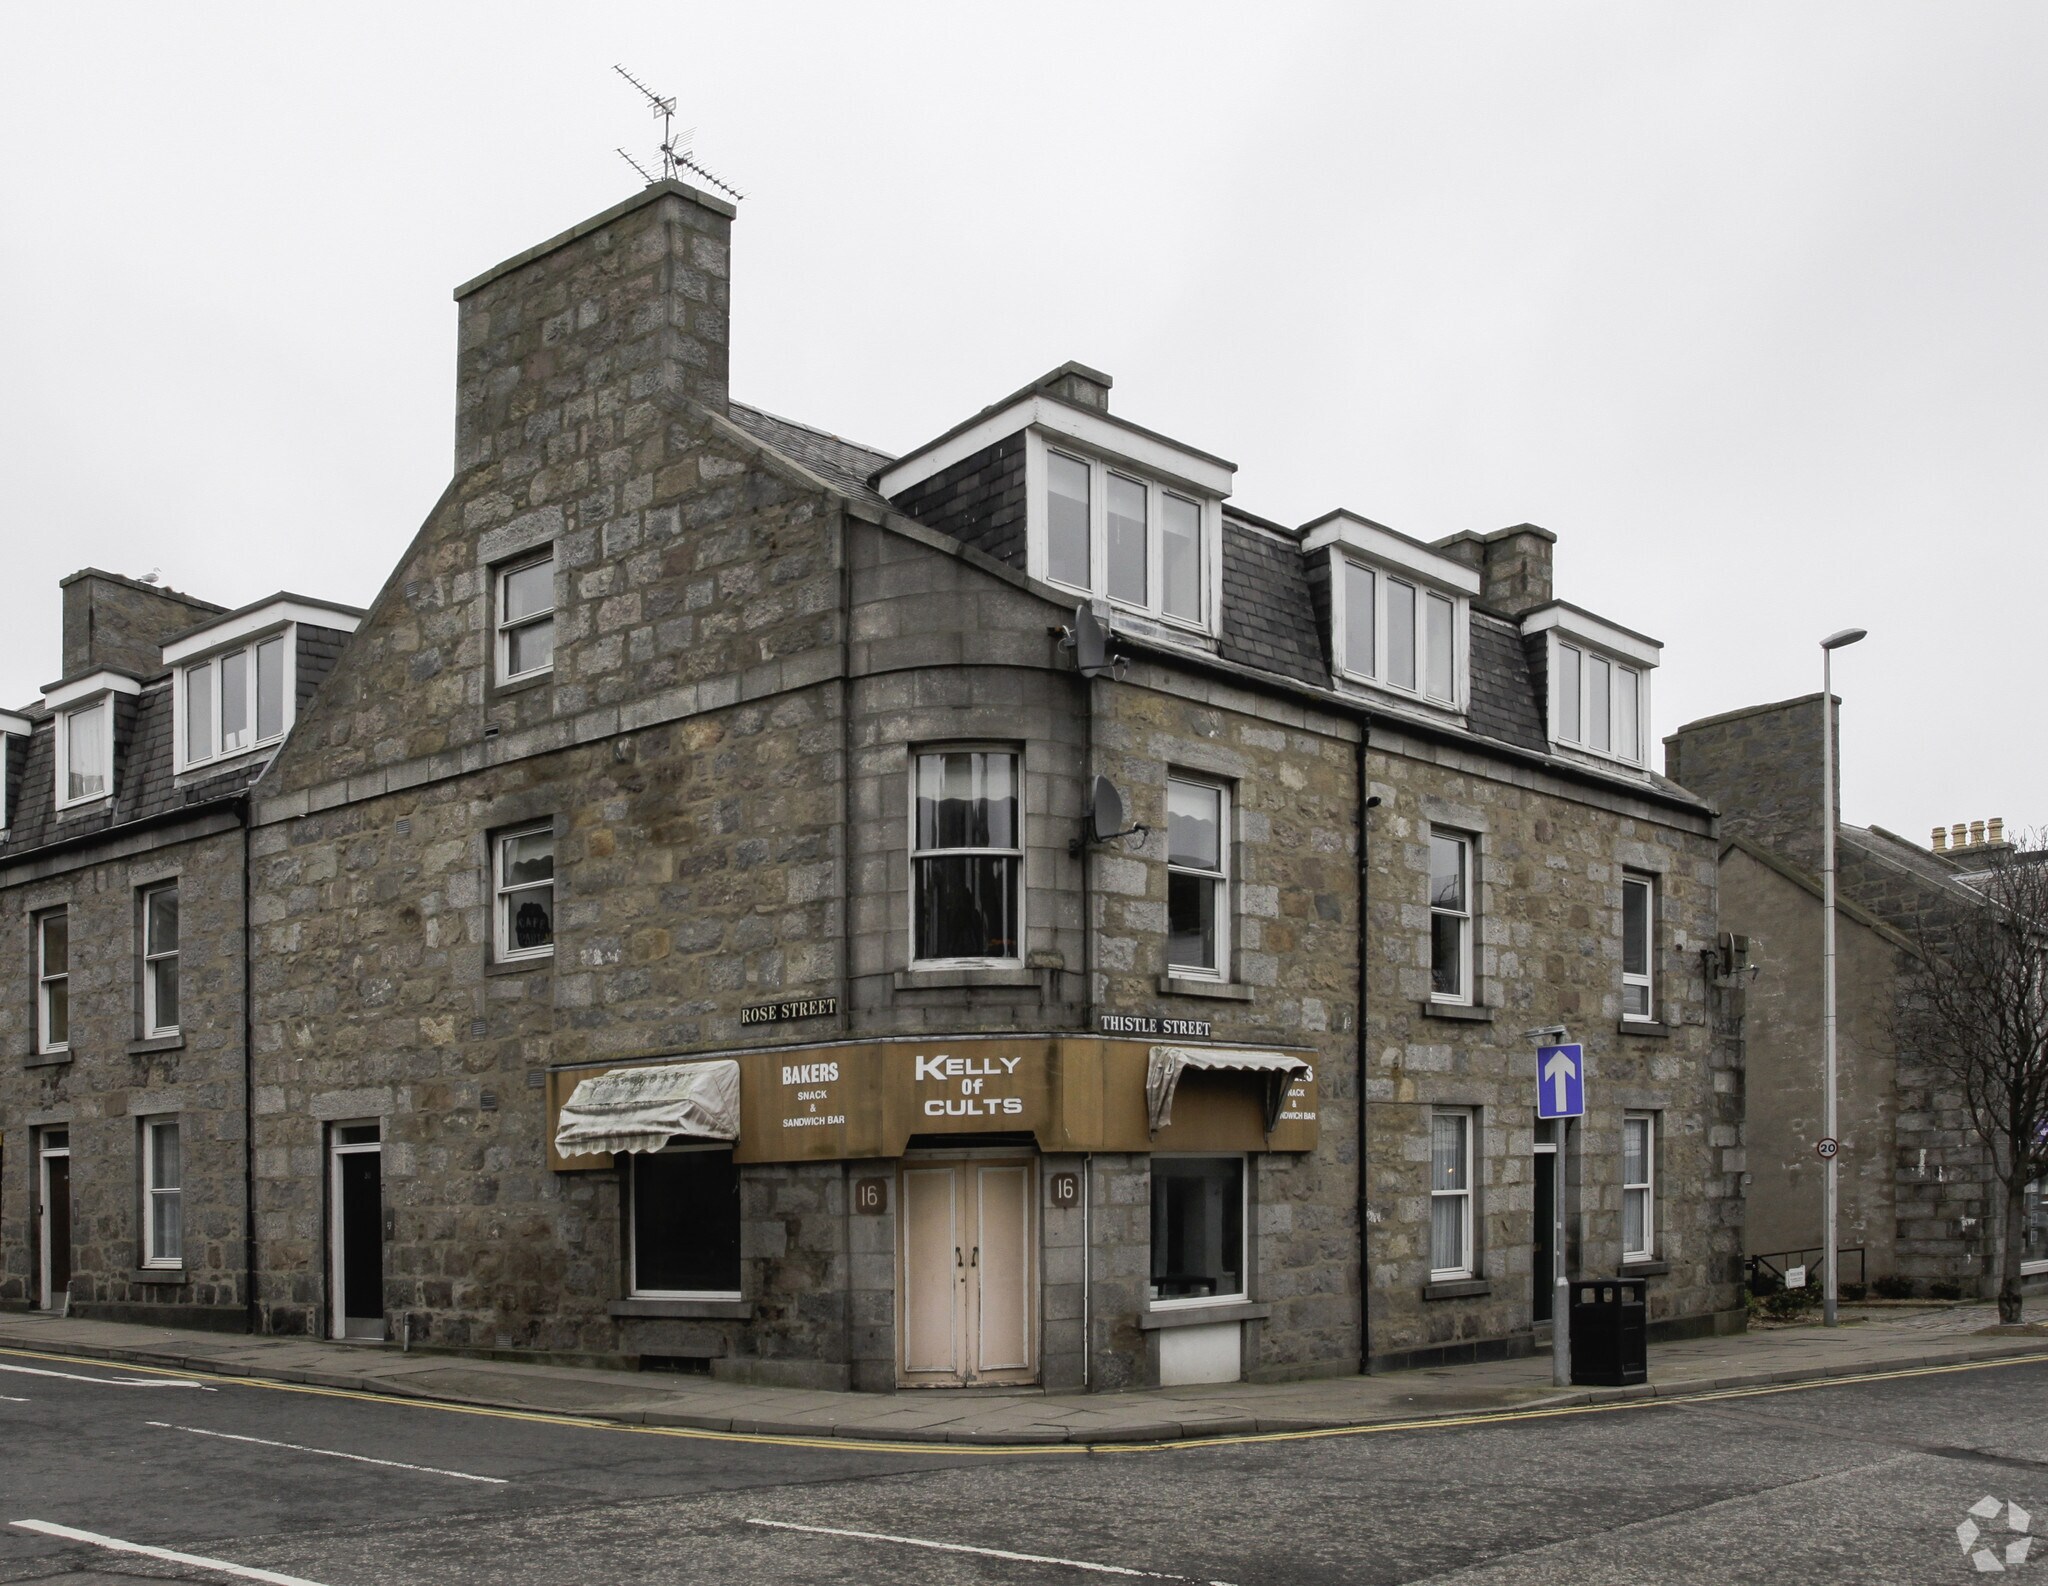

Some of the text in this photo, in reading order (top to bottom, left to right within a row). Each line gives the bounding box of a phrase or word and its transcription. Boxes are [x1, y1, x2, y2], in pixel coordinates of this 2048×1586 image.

[741, 998, 836, 1023] ROSE STREET
[1101, 1015, 1211, 1036] THISTLE STREET
[782, 1061, 839, 1085] BAKERS
[915, 1054, 1022, 1081] KELLY
[797, 1089, 827, 1101] SNACK
[961, 1078, 984, 1095] Of
[1287, 1088, 1305, 1097] NACK
[809, 1103, 817, 1113] &
[924, 1098, 1023, 1116] CULTS
[1280, 1111, 1316, 1120] NDWICH BAR
[782, 1115, 845, 1128] SANDWICH BAR
[1820, 1143, 1836, 1153] 20
[861, 1185, 878, 1207] 16
[1058, 1178, 1073, 1199] 16
